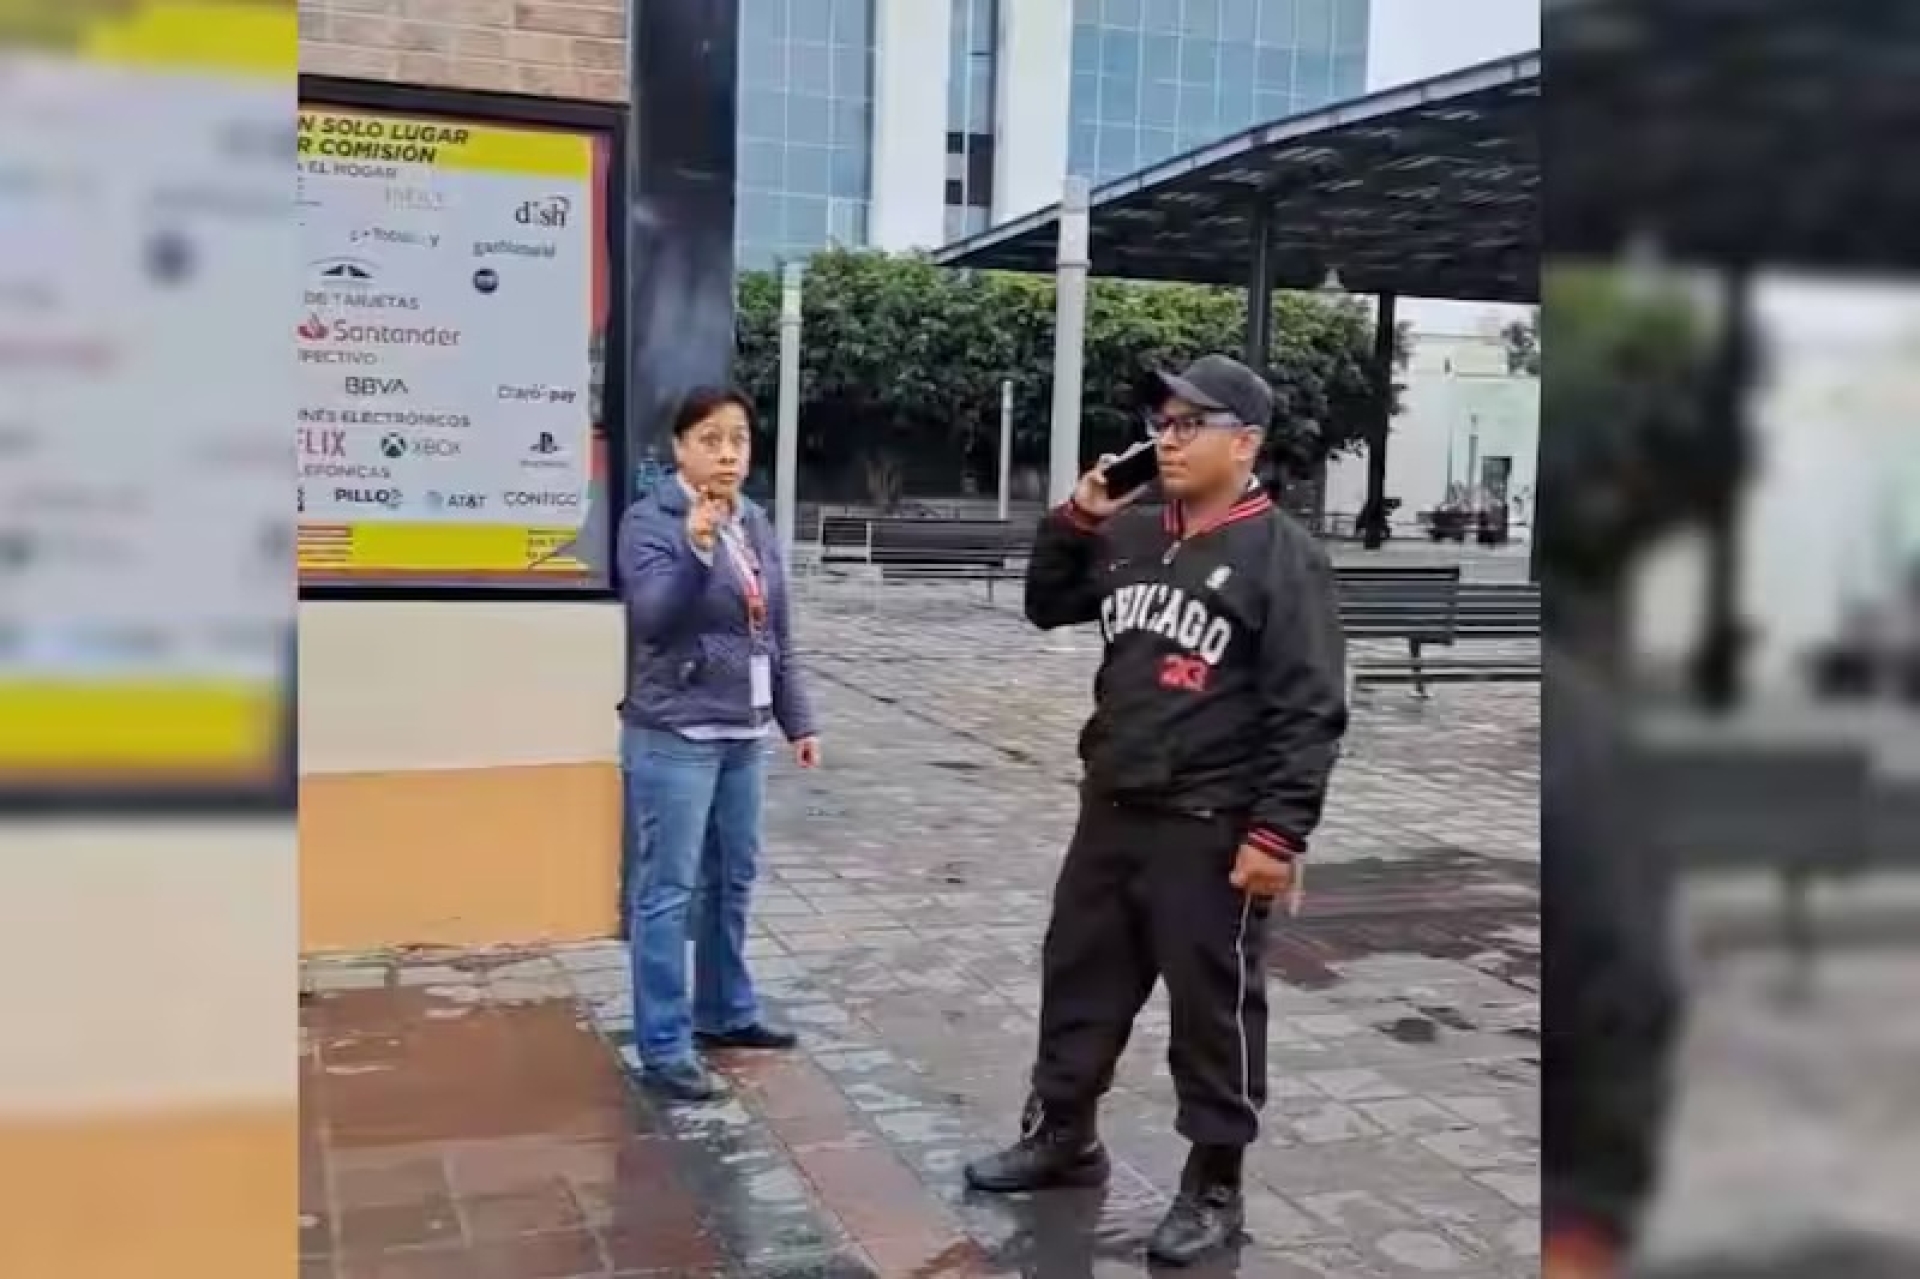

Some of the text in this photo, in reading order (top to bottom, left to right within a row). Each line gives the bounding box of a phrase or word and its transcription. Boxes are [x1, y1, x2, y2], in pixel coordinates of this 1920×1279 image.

[321, 117, 385, 138] SOLO
[390, 124, 469, 145] LUGAR
[333, 163, 398, 178] HOGAR
[304, 291, 420, 310] DE TARJETAS
[333, 318, 461, 346] Santander
[345, 376, 409, 397] BBVA
[411, 438, 462, 456] XBOX
[447, 492, 487, 508] AT&T
[1101, 583, 1232, 665] CHICAGO
